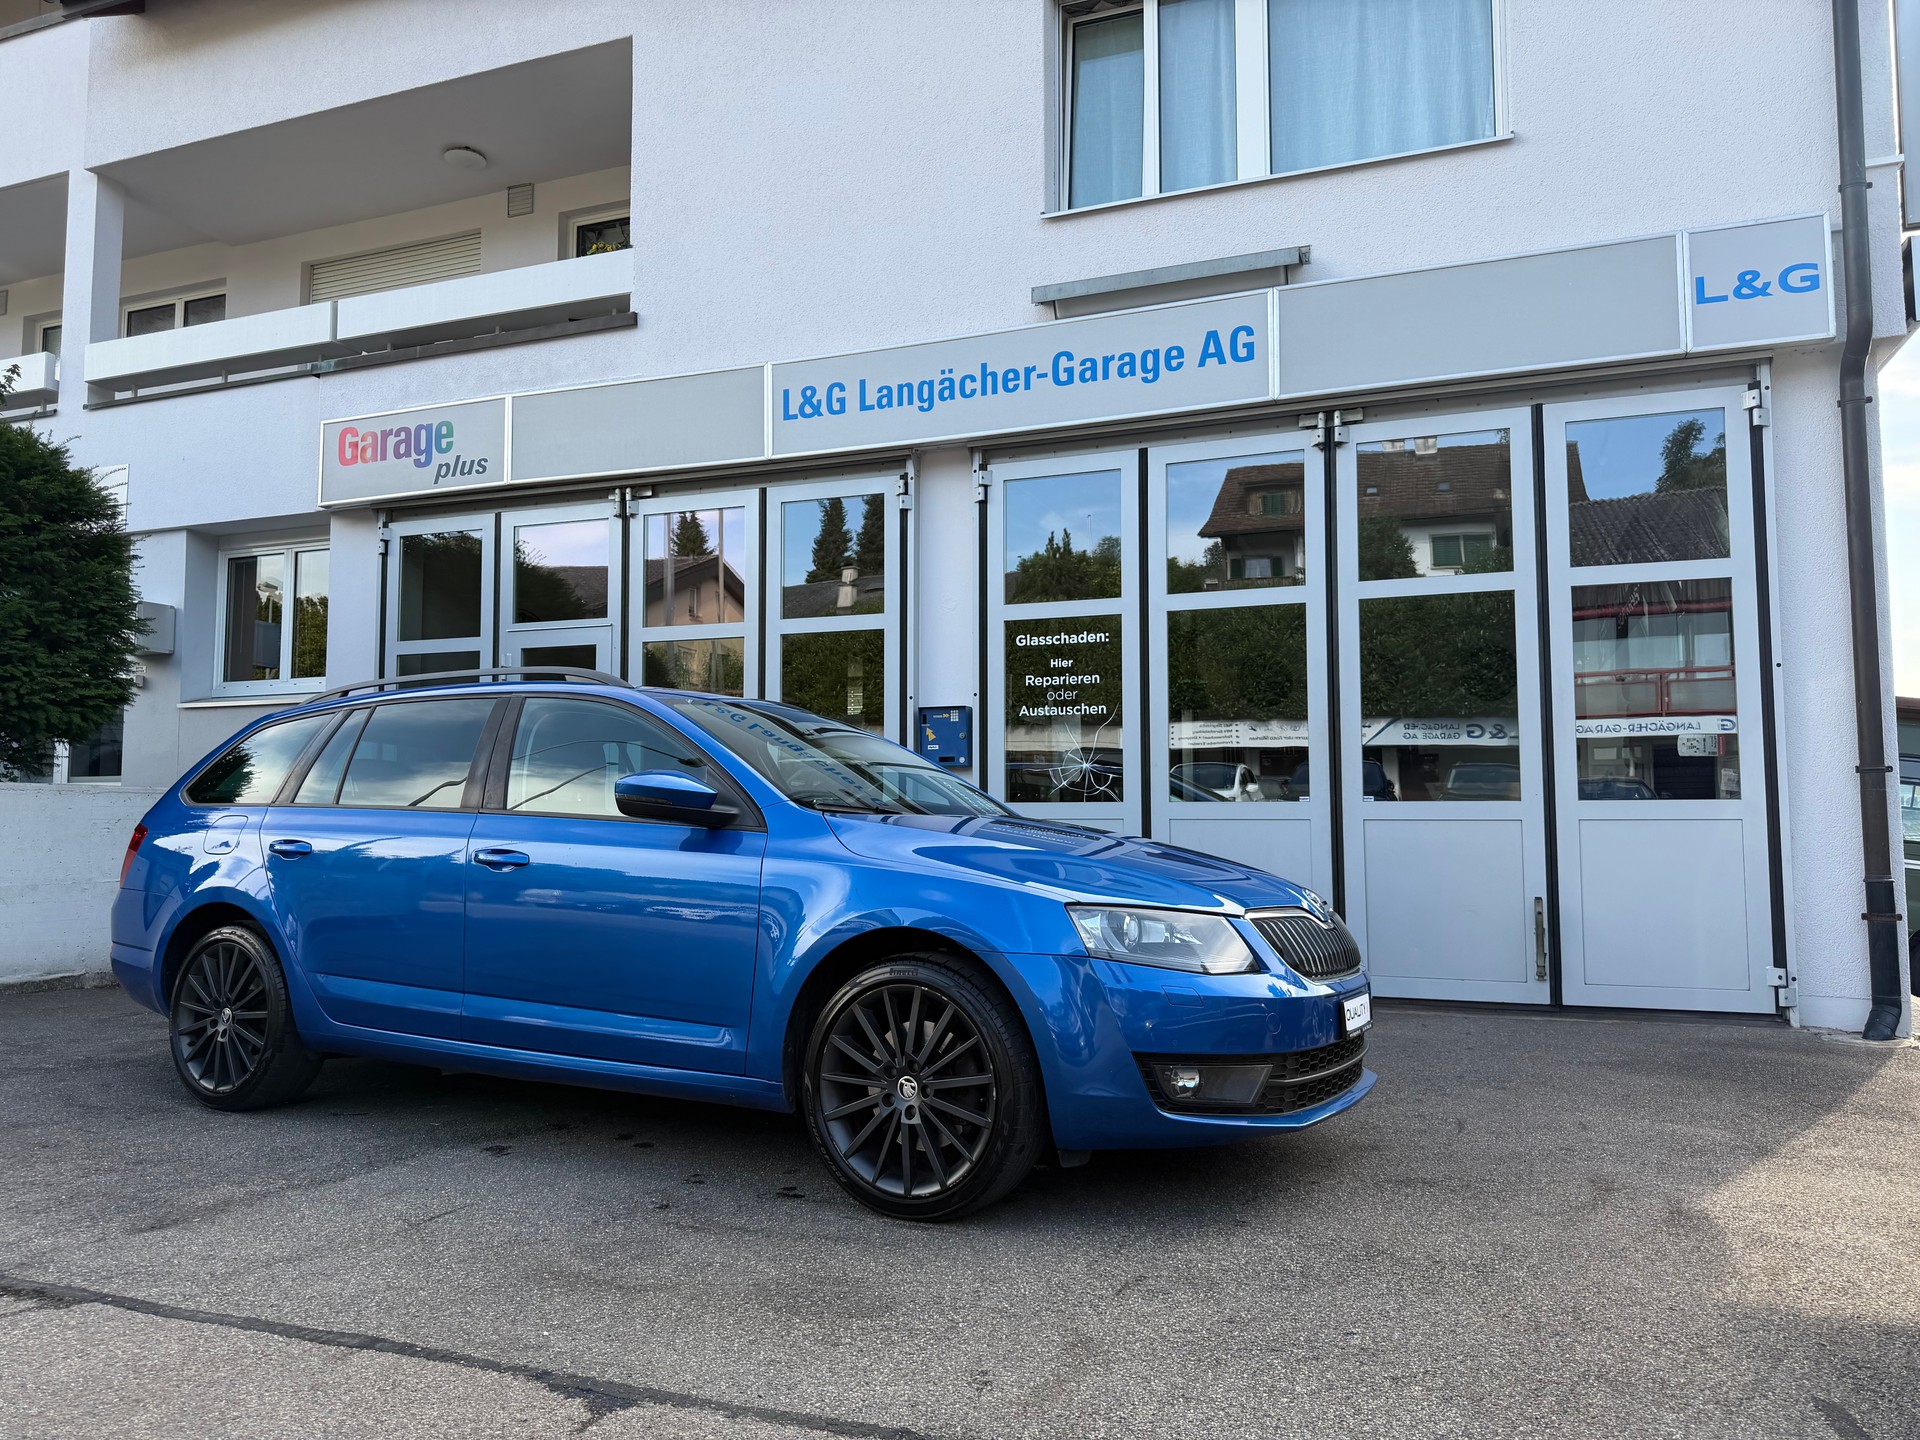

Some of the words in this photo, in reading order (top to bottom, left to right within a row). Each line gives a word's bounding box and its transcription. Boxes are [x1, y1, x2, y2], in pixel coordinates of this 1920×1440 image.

[1695, 262, 1820, 305] L&G
[782, 381, 847, 421] L&G
[859, 344, 1185, 412] Langächer-Garage
[1197, 325, 1256, 368] AG
[338, 420, 454, 469] Garage
[433, 453, 489, 485] plus
[1015, 631, 1110, 647] Glasschaden:
[1050, 658, 1073, 668] Hier
[1025, 673, 1100, 687] Reparieren
[1046, 689, 1078, 701] oder
[1019, 704, 1107, 717] Austauschen
